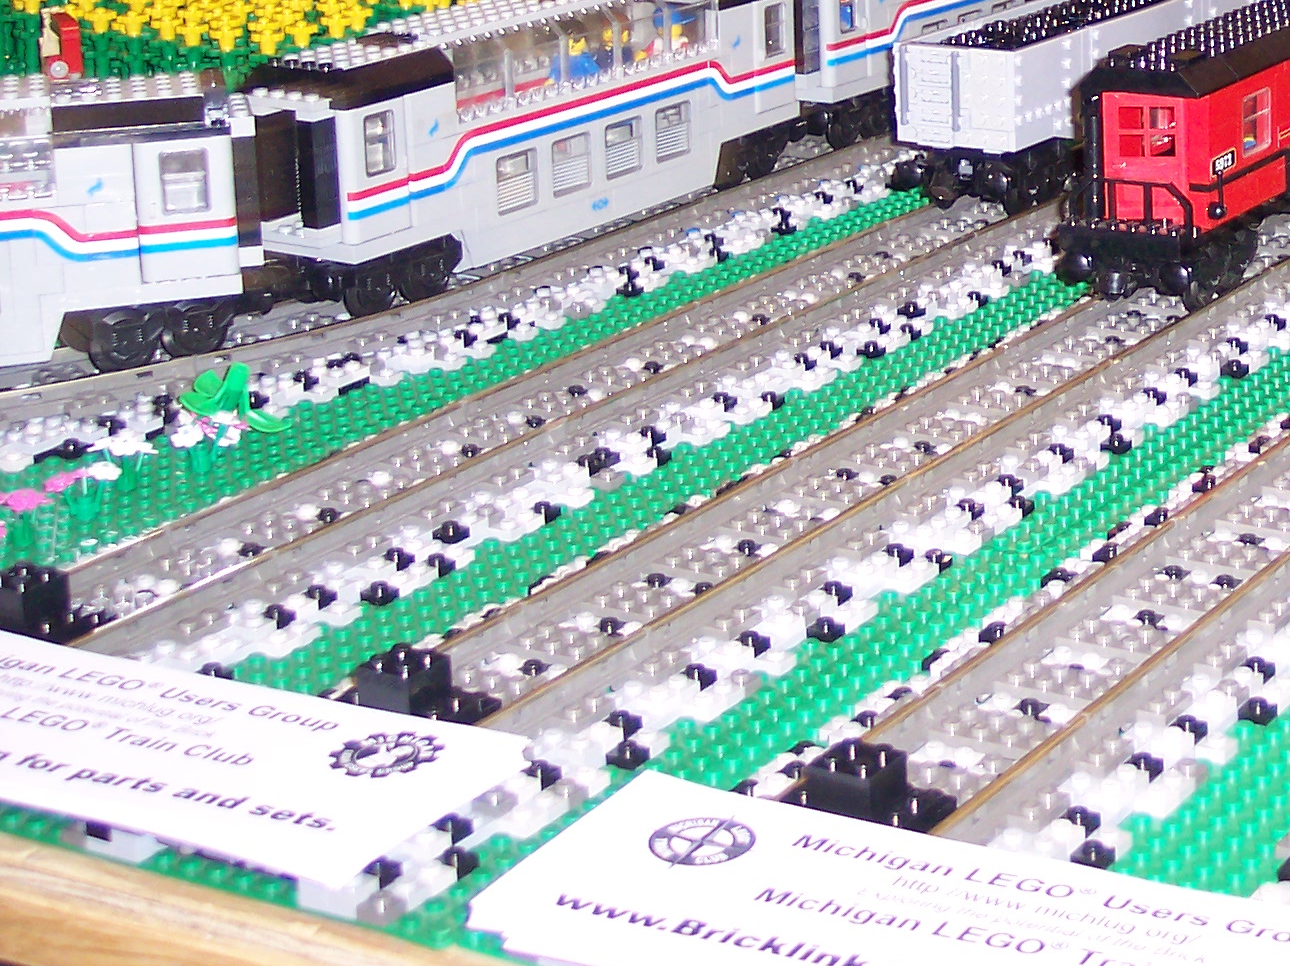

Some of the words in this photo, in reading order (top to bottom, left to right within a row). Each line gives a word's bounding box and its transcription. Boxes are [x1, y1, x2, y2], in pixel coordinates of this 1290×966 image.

[159, 686, 242, 713] Users
[249, 705, 340, 732] Group
[105, 727, 179, 752] Train
[183, 744, 255, 766] Club
[16, 753, 70, 772] for
[64, 768, 169, 793] parts
[172, 788, 250, 810] and
[249, 805, 338, 831] sets.
[791, 833, 953, 877] Michigan
[1102, 894, 1210, 927] Users
[754, 887, 922, 932] Michigan
